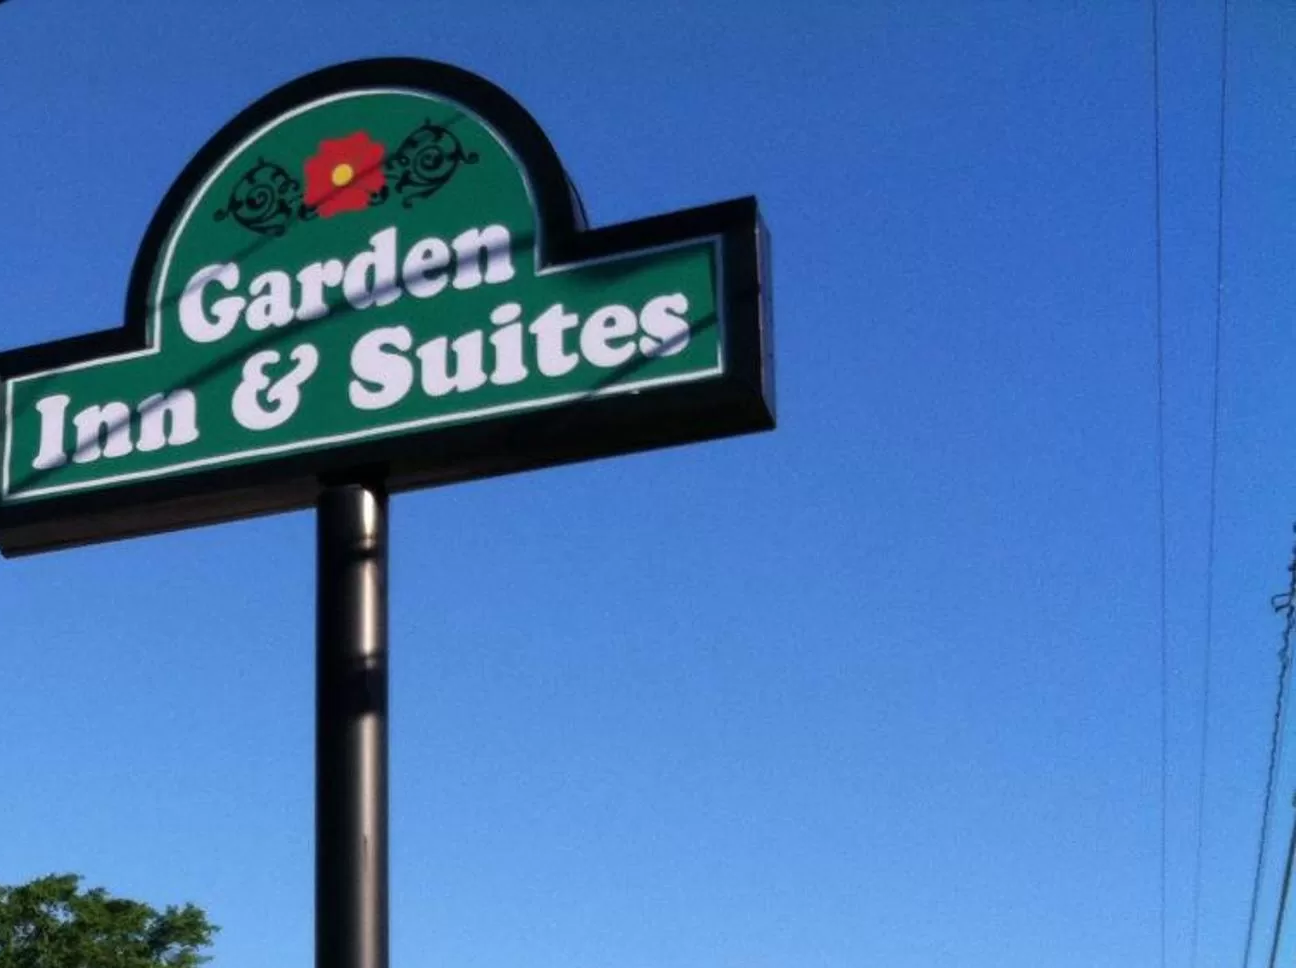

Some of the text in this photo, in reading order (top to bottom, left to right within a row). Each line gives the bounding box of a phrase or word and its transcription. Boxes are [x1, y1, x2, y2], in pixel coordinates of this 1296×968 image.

[178, 224, 515, 343] Garden
[32, 292, 690, 470] Inn & Suites
